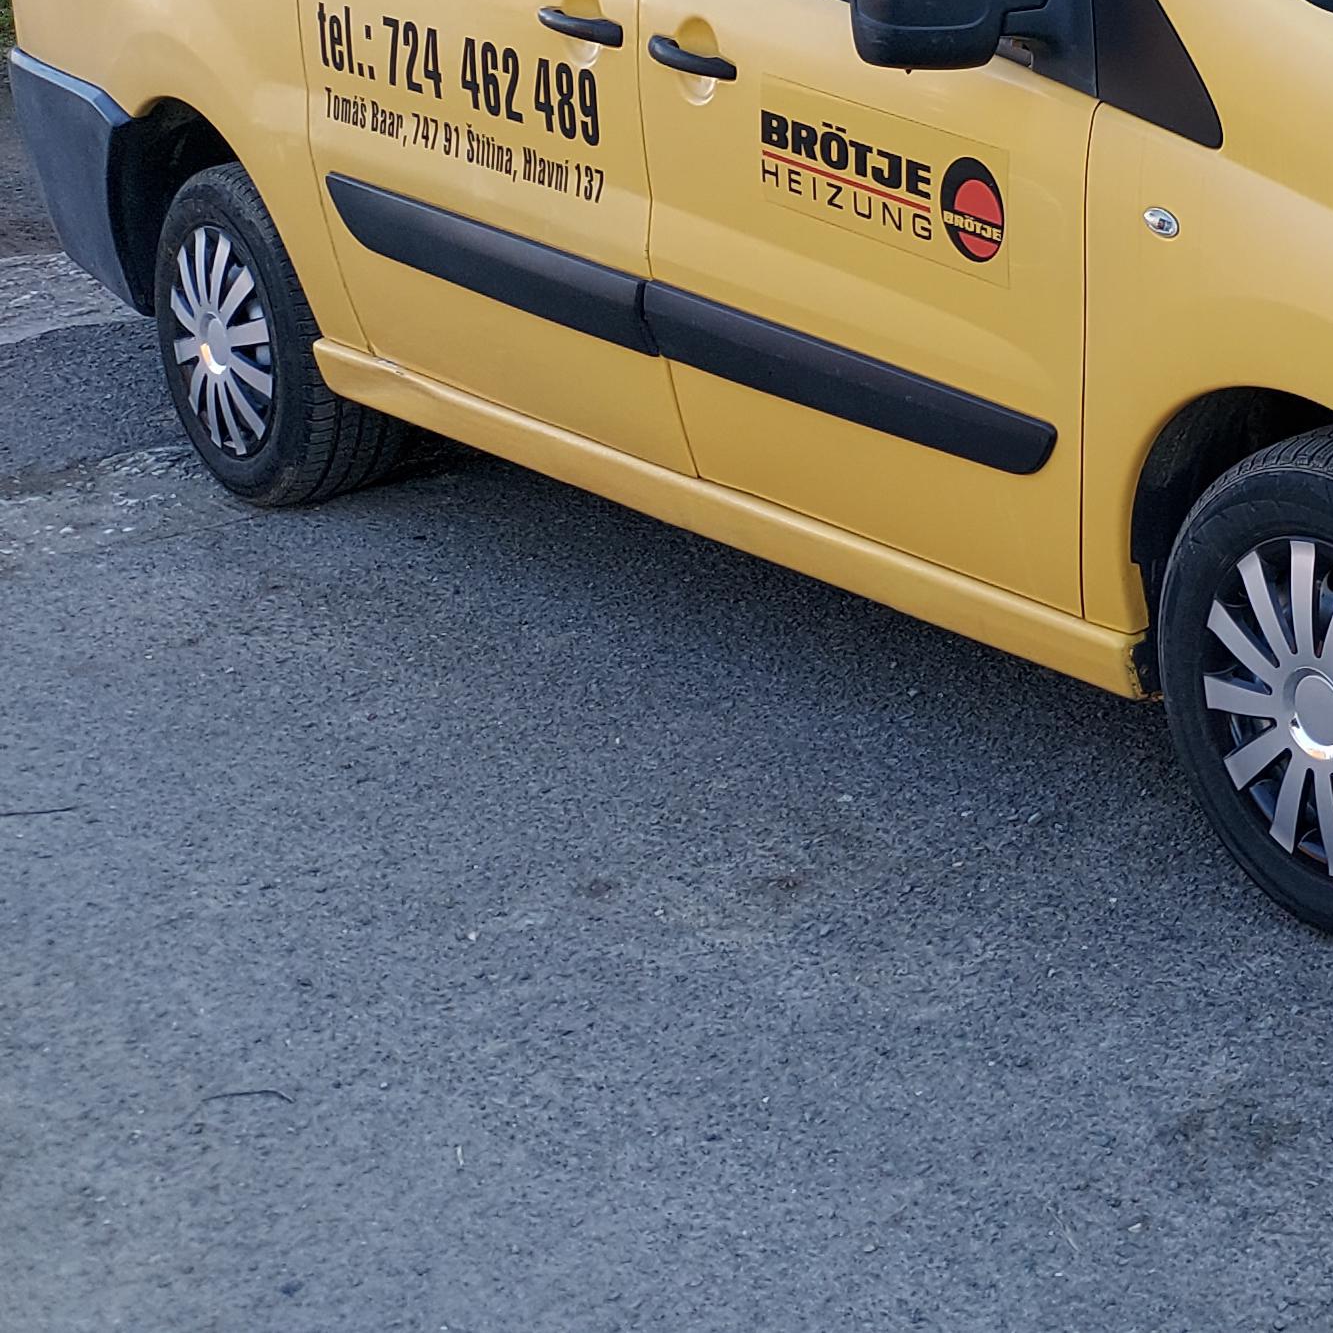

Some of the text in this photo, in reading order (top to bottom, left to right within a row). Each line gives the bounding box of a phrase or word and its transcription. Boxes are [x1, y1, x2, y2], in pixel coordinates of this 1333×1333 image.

[317, 2, 600, 147] tel.: 724 462 489
[325, 86, 604, 204] Tomáš Baar, 747 91 Štítina, Hlavní 137
[761, 109, 932, 200] BRÖTJE
[761, 159, 933, 241] HEIZUNG
[943, 210, 1003, 243] BRÖTJE
